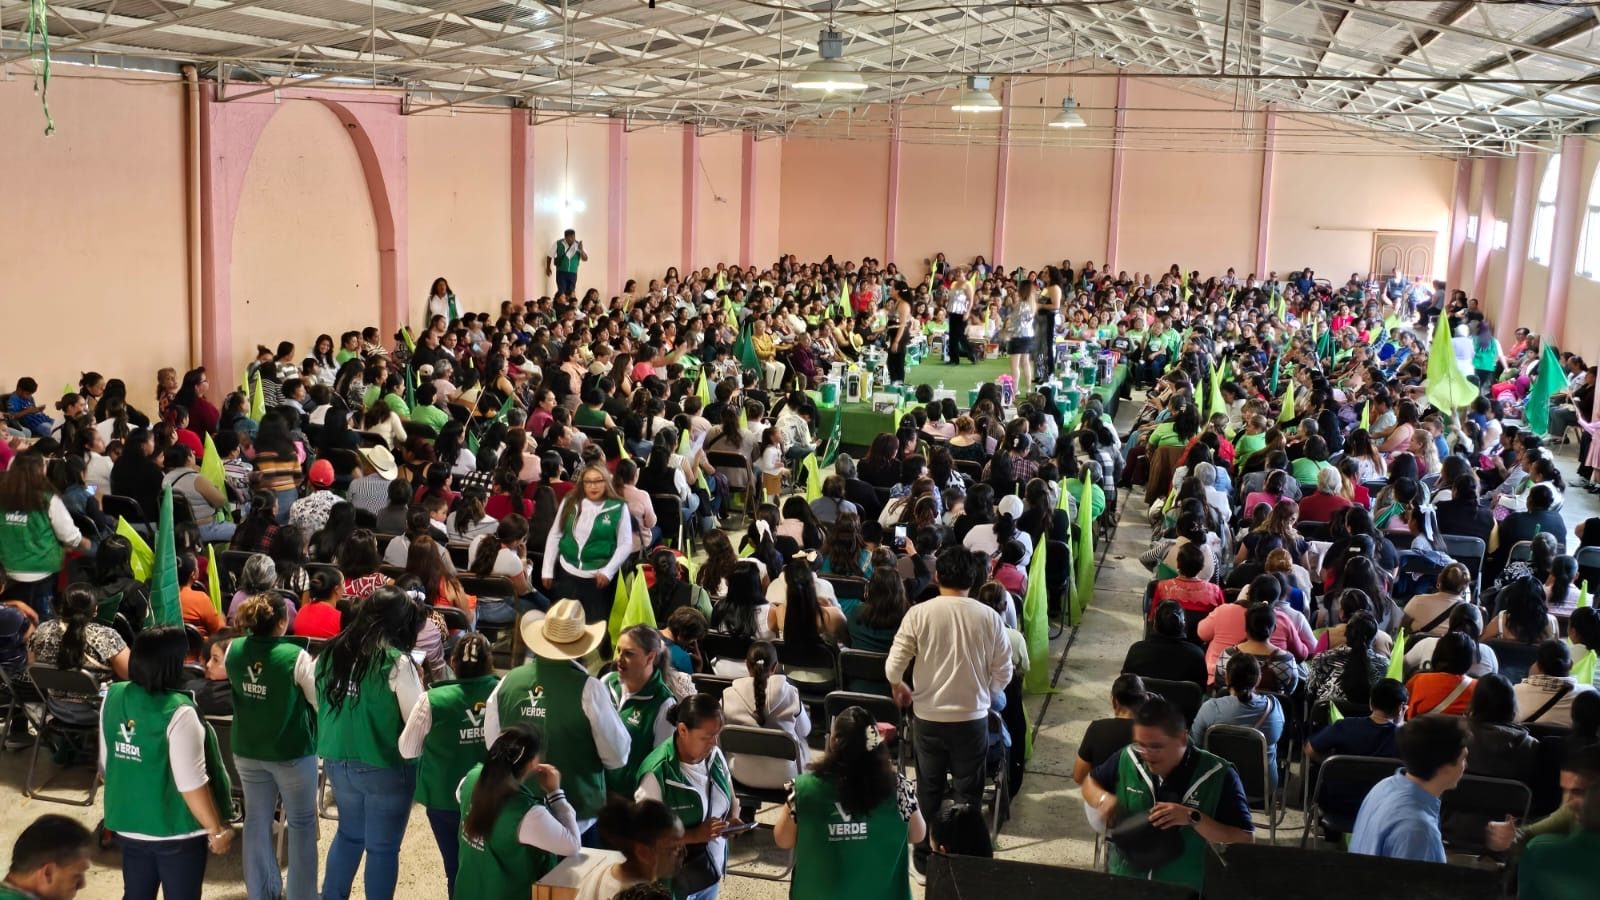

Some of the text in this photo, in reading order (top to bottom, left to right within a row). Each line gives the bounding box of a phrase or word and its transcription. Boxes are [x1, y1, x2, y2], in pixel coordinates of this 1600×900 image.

[242, 681, 267, 695] VERDE
[520, 706, 546, 718] VERDE
[459, 727, 486, 739] VERD
[828, 822, 868, 835] VERDE
